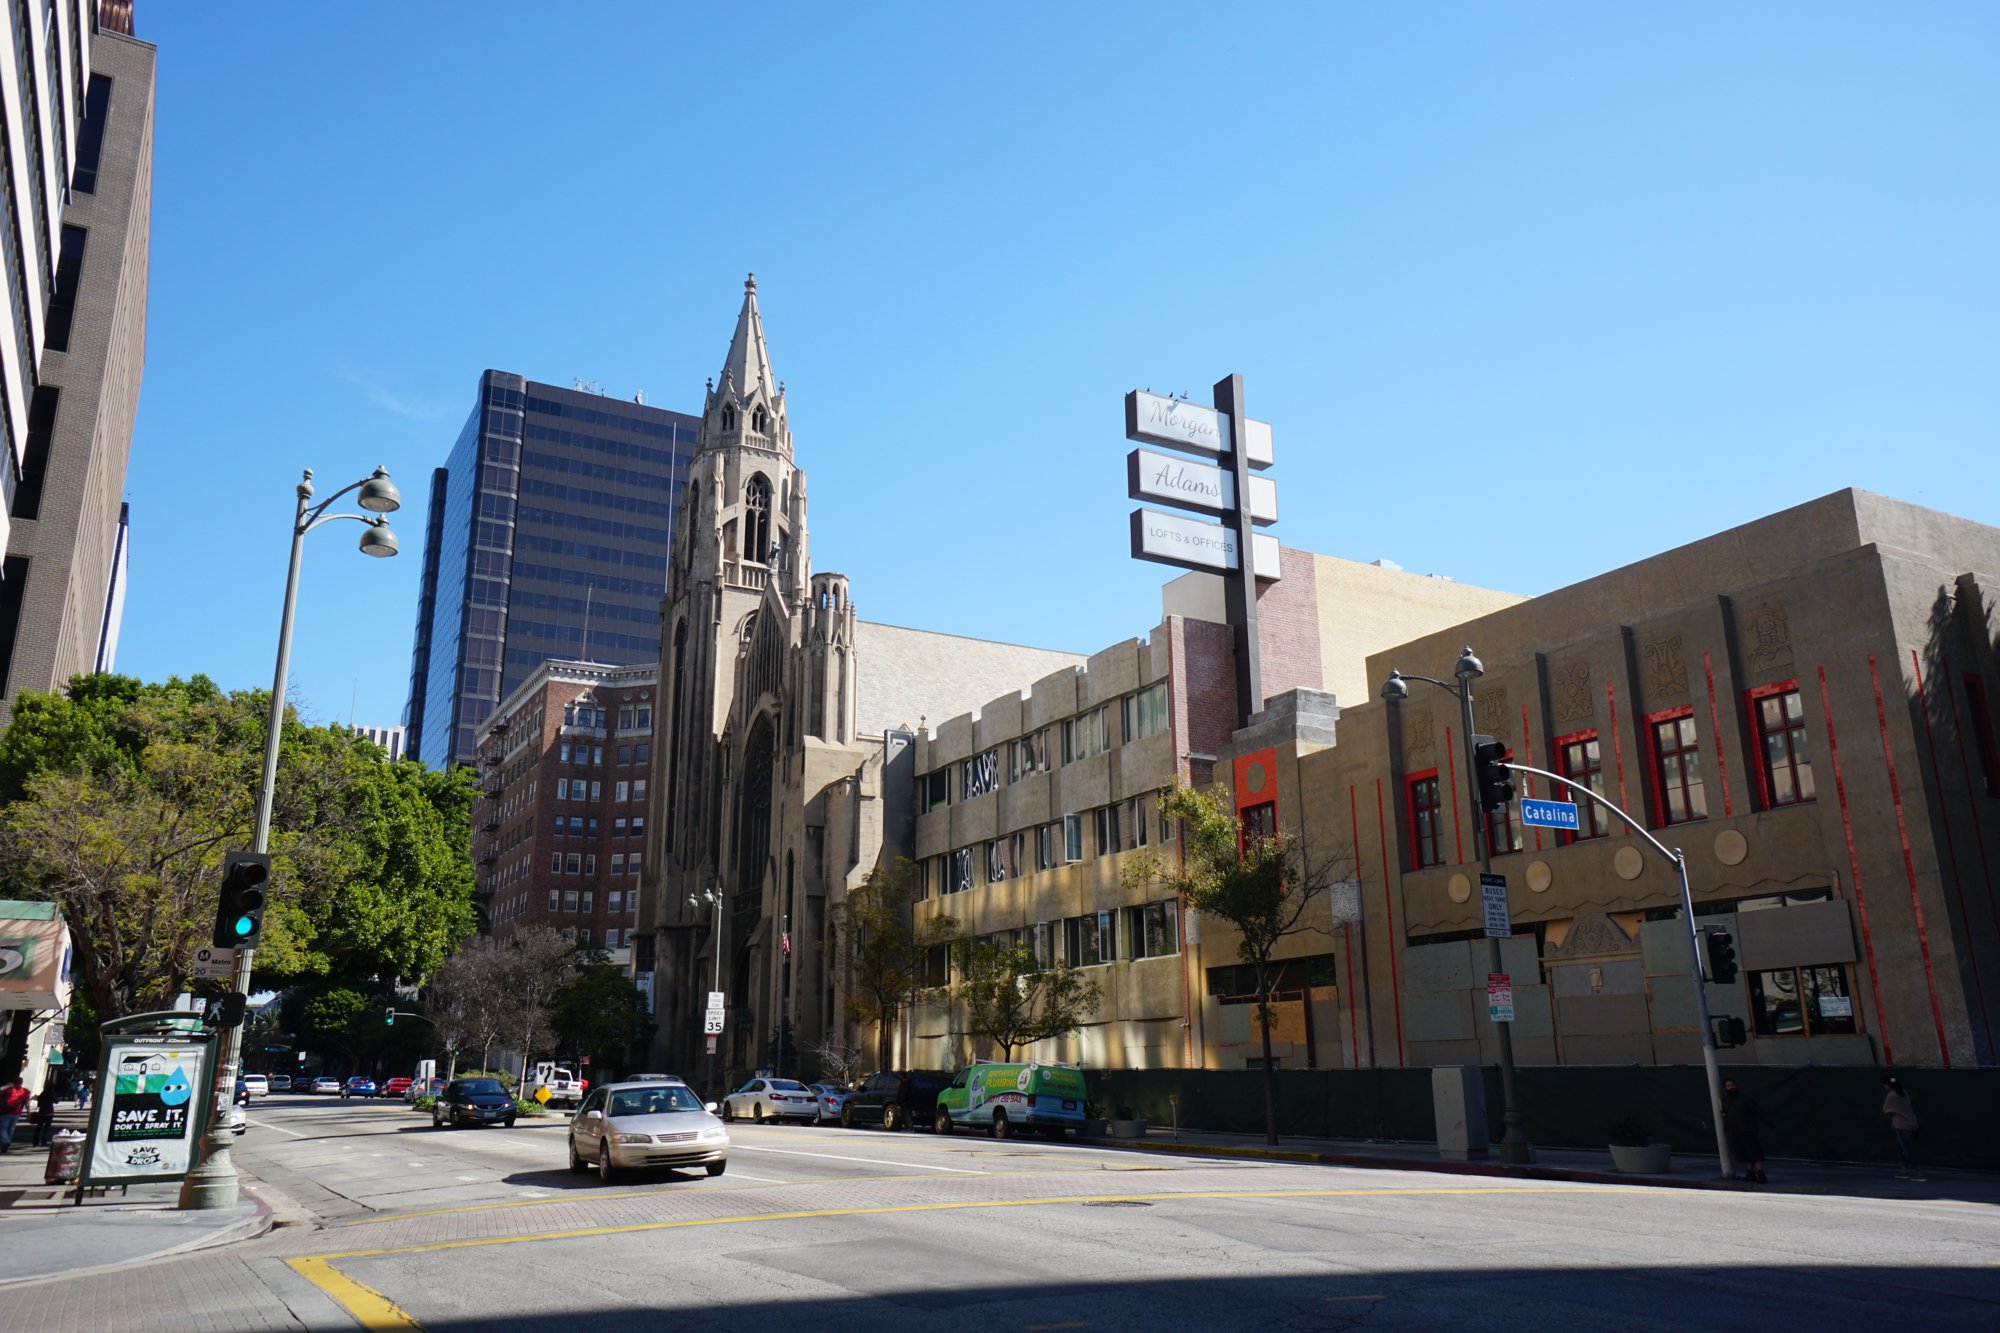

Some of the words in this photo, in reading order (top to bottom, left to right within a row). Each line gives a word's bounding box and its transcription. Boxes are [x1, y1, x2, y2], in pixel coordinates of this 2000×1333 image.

[1149, 399, 1223, 438] Morgan
[1155, 463, 1220, 497] Adams
[1150, 527, 1182, 543] LOFTS
[1184, 534, 1190, 544] &
[1192, 536, 1234, 553] OFFICES
[1525, 805, 1575, 823] Catalina
[1484, 887, 1504, 896] BUSES
[1488, 903, 1503, 911] ONLY
[707, 1022, 722, 1031] 35
[985, 1078, 1018, 1088] PLUMBING
[116, 1109, 158, 1123] SAVE
[165, 1109, 184, 1121] IT,
[114, 1123, 141, 1131] DON'T
[144, 1122, 170, 1130] SPRAY
[132, 1146, 158, 1155] SAVE
[130, 1156, 157, 1165] DROP
